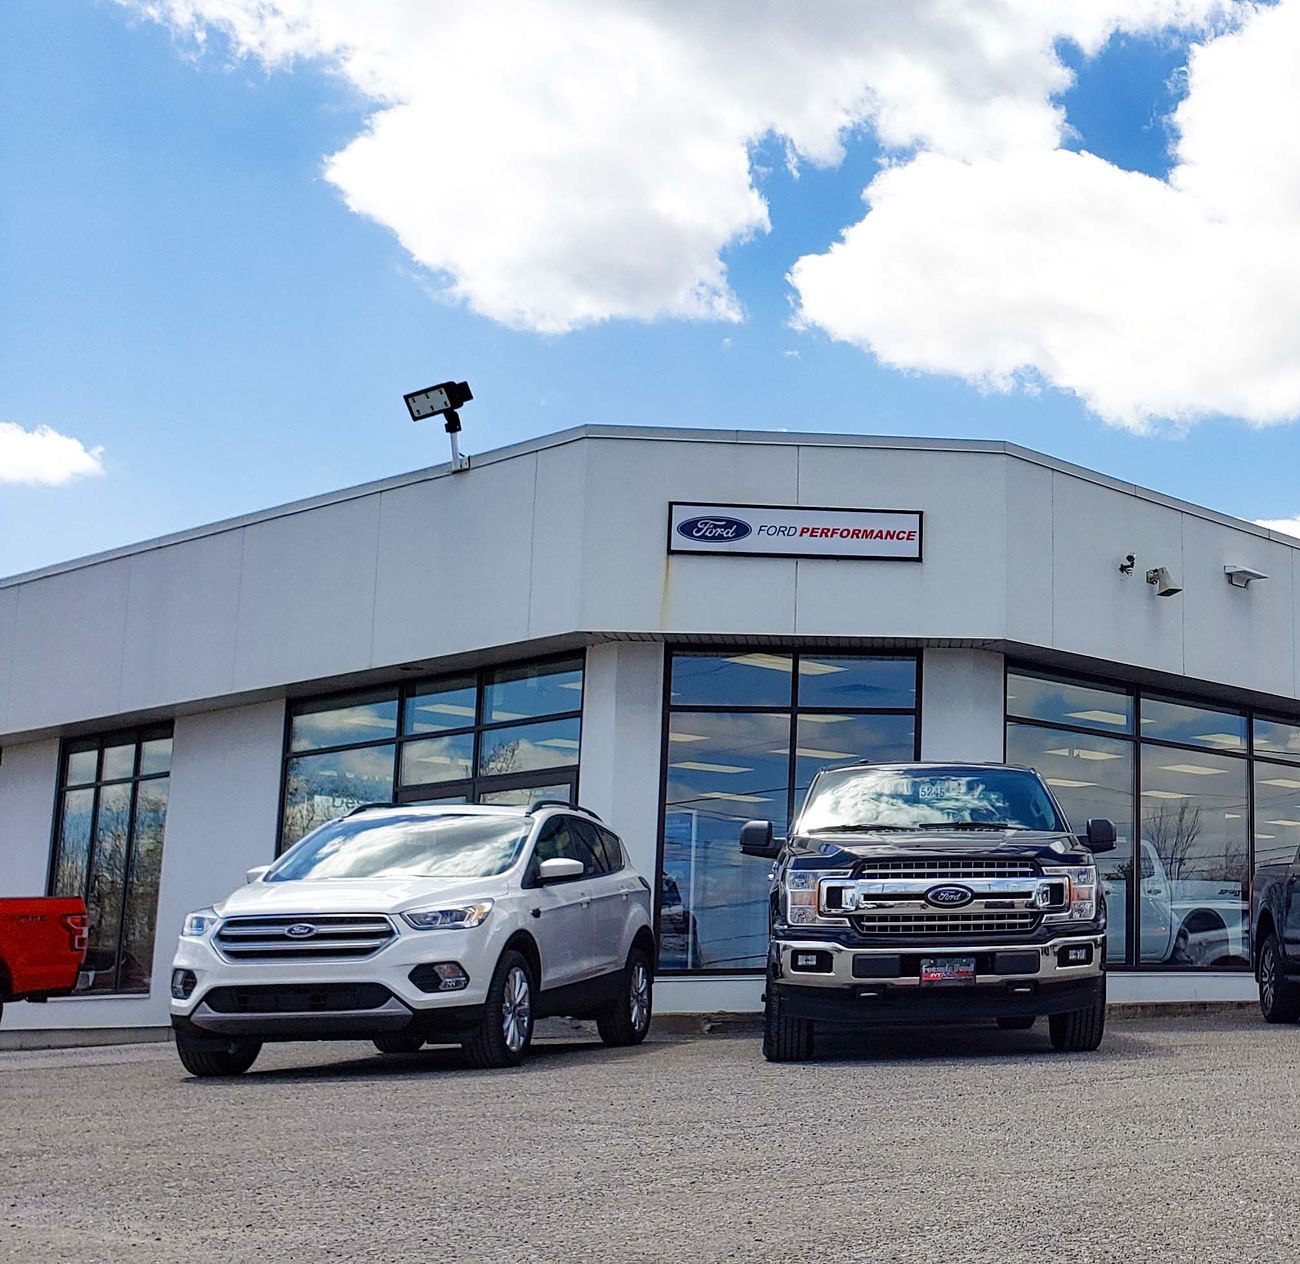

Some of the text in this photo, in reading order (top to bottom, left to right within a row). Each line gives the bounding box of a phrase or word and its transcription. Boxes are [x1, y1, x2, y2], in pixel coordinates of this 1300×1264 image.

[692, 519, 737, 538] Ford
[757, 524, 917, 541] FORD PERFORMANCE
[938, 890, 961, 901] Ford
